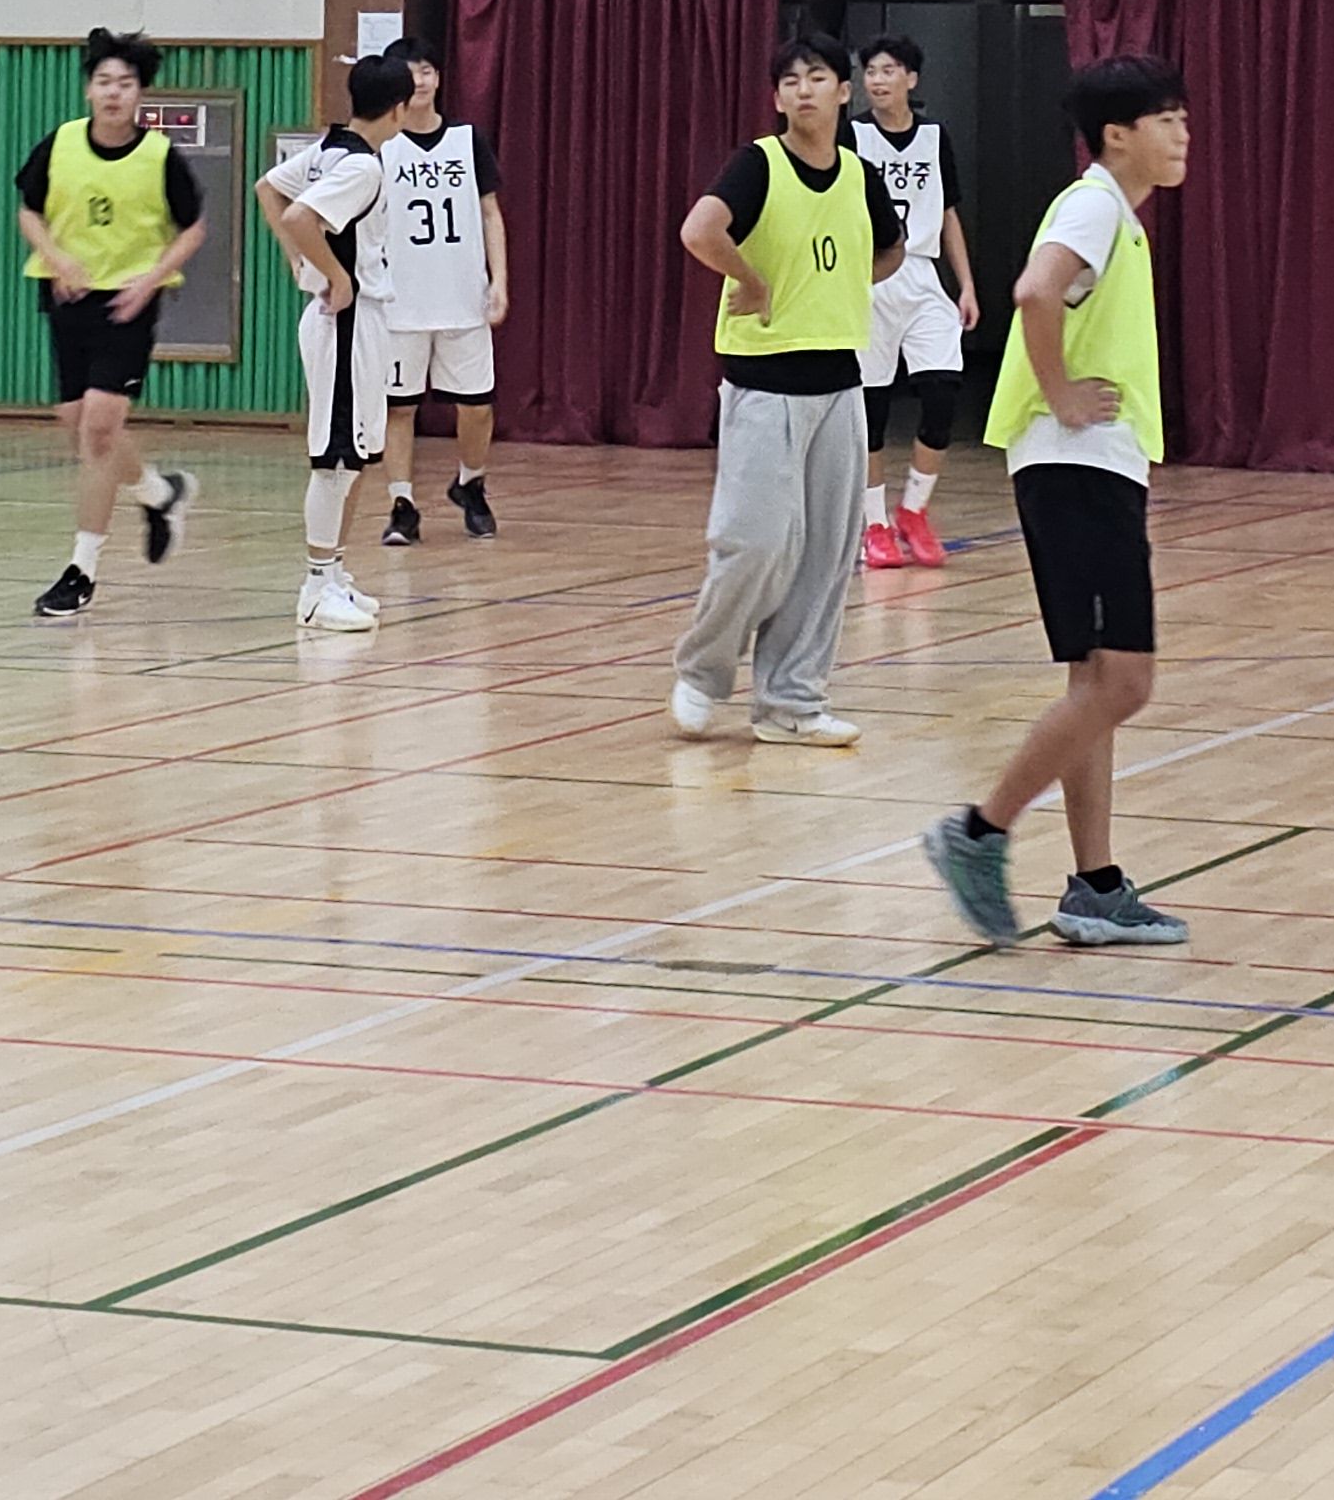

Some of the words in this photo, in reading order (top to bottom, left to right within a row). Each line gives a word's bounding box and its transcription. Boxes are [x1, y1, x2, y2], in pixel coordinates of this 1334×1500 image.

[394, 159, 466, 189] 서창중
[407, 197, 461, 245] 31
[812, 235, 837, 272] 10
